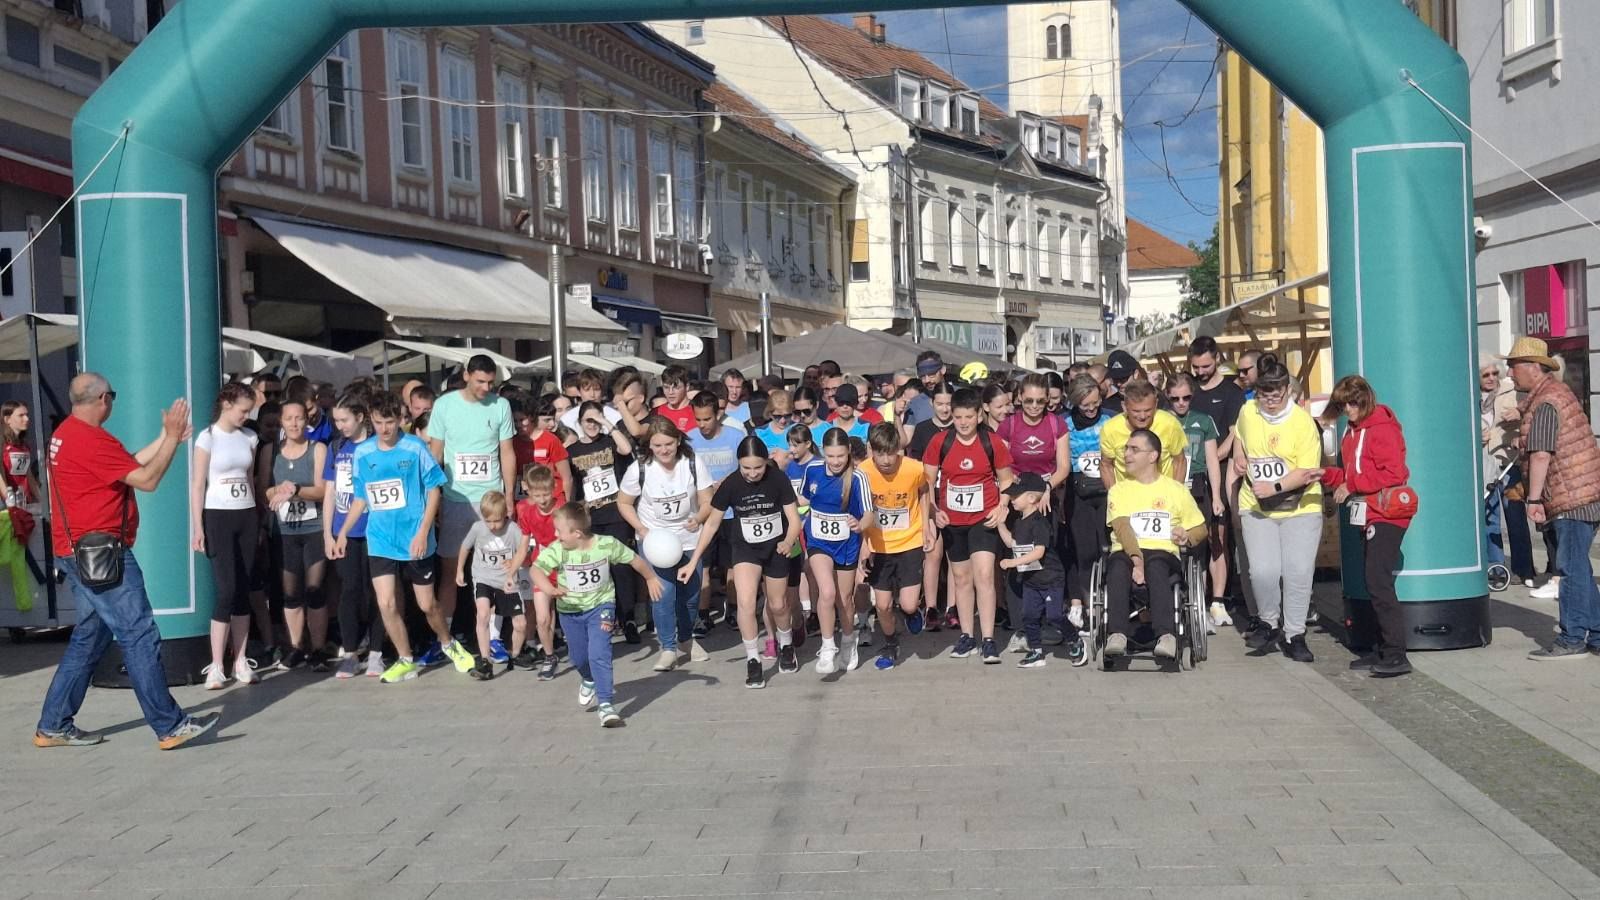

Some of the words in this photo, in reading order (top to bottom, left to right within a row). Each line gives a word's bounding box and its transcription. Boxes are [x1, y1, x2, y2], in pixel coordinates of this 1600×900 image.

[1526, 311, 1550, 335] BIPA
[978, 337, 998, 351] LOGOS
[460, 461, 489, 475] 124
[1253, 462, 1284, 479] 300
[230, 483, 248, 498] 69
[592, 477, 610, 493] 85
[370, 487, 400, 505] 159
[896, 492, 908, 500] 22
[955, 492, 975, 507] 47
[287, 501, 307, 515] 48
[662, 500, 681, 515] 37
[879, 513, 899, 526] 87
[1141, 517, 1161, 533] 78
[753, 521, 773, 537] 89
[820, 520, 841, 535] 88
[577, 568, 601, 587] 38
